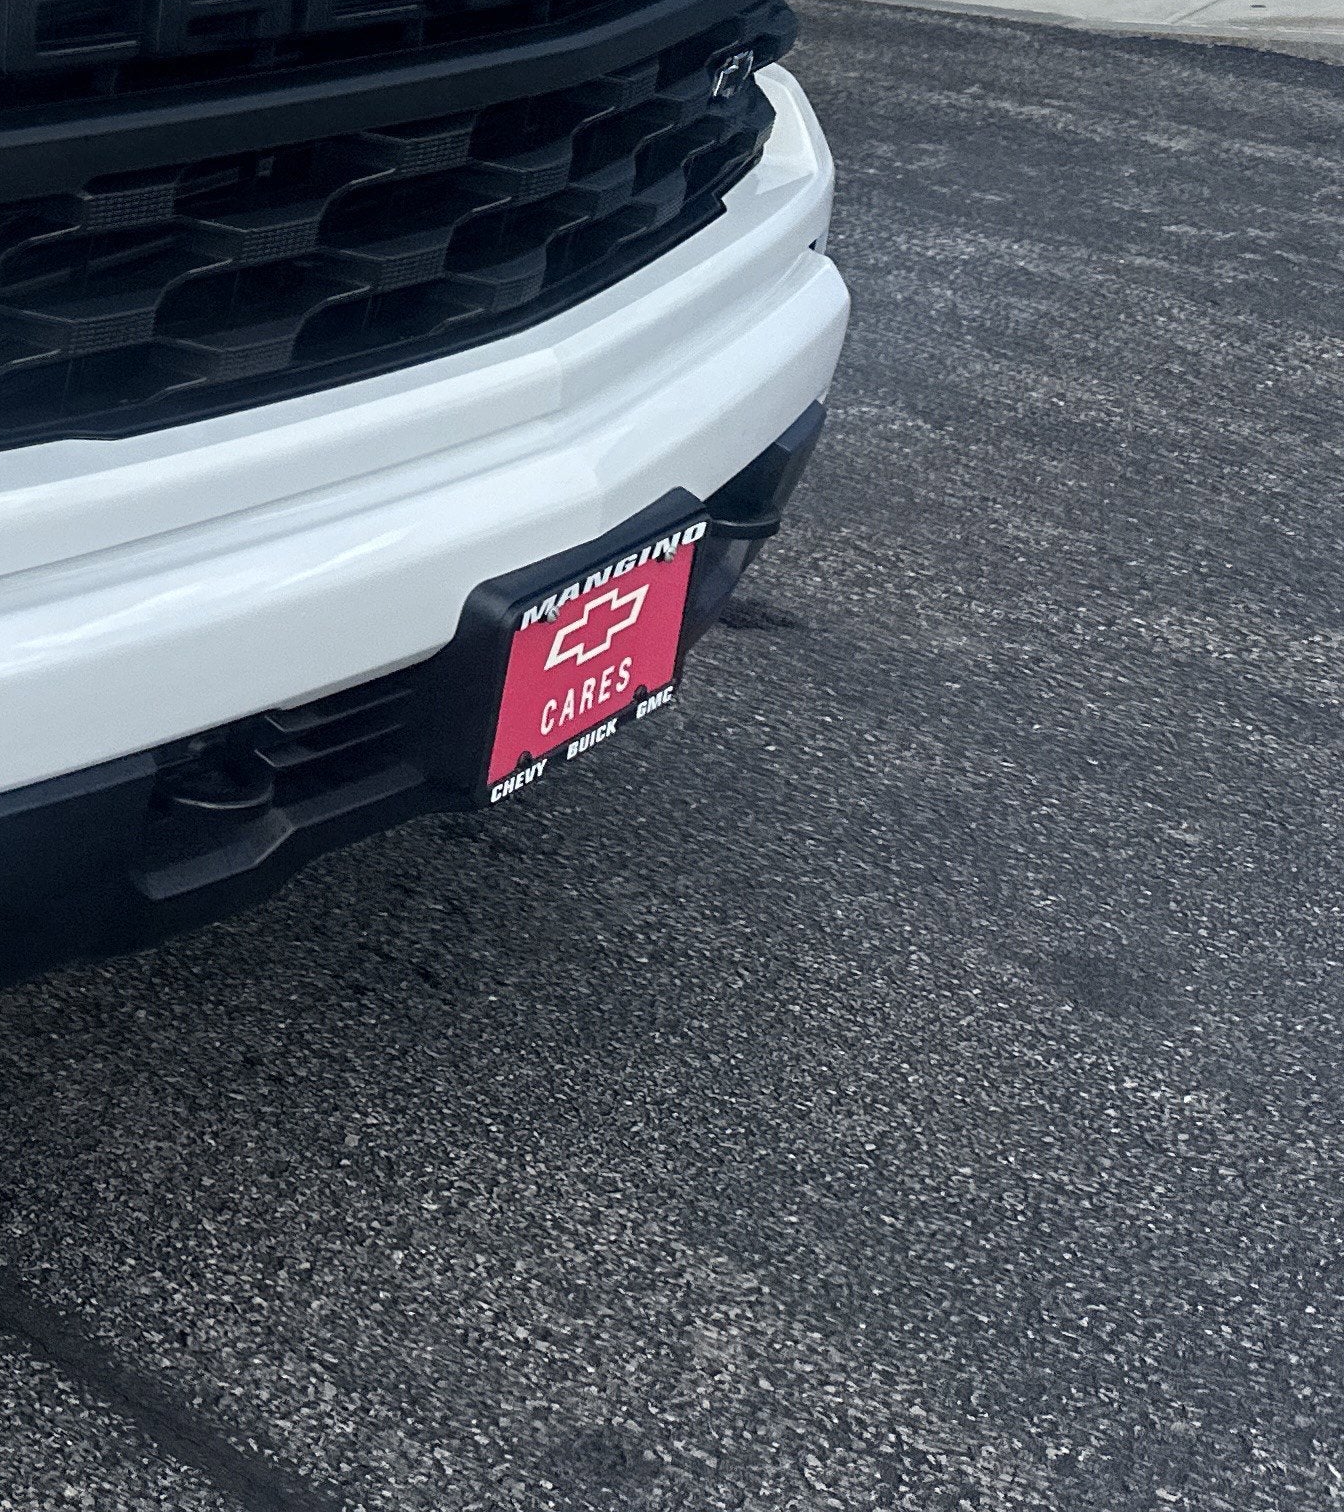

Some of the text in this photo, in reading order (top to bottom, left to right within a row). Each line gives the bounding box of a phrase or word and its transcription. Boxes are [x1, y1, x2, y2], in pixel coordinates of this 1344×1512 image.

[518, 520, 708, 632] MANGINO
[490, 685, 674, 804] CHEVY BUICK GMC
[539, 656, 633, 736] CARES
